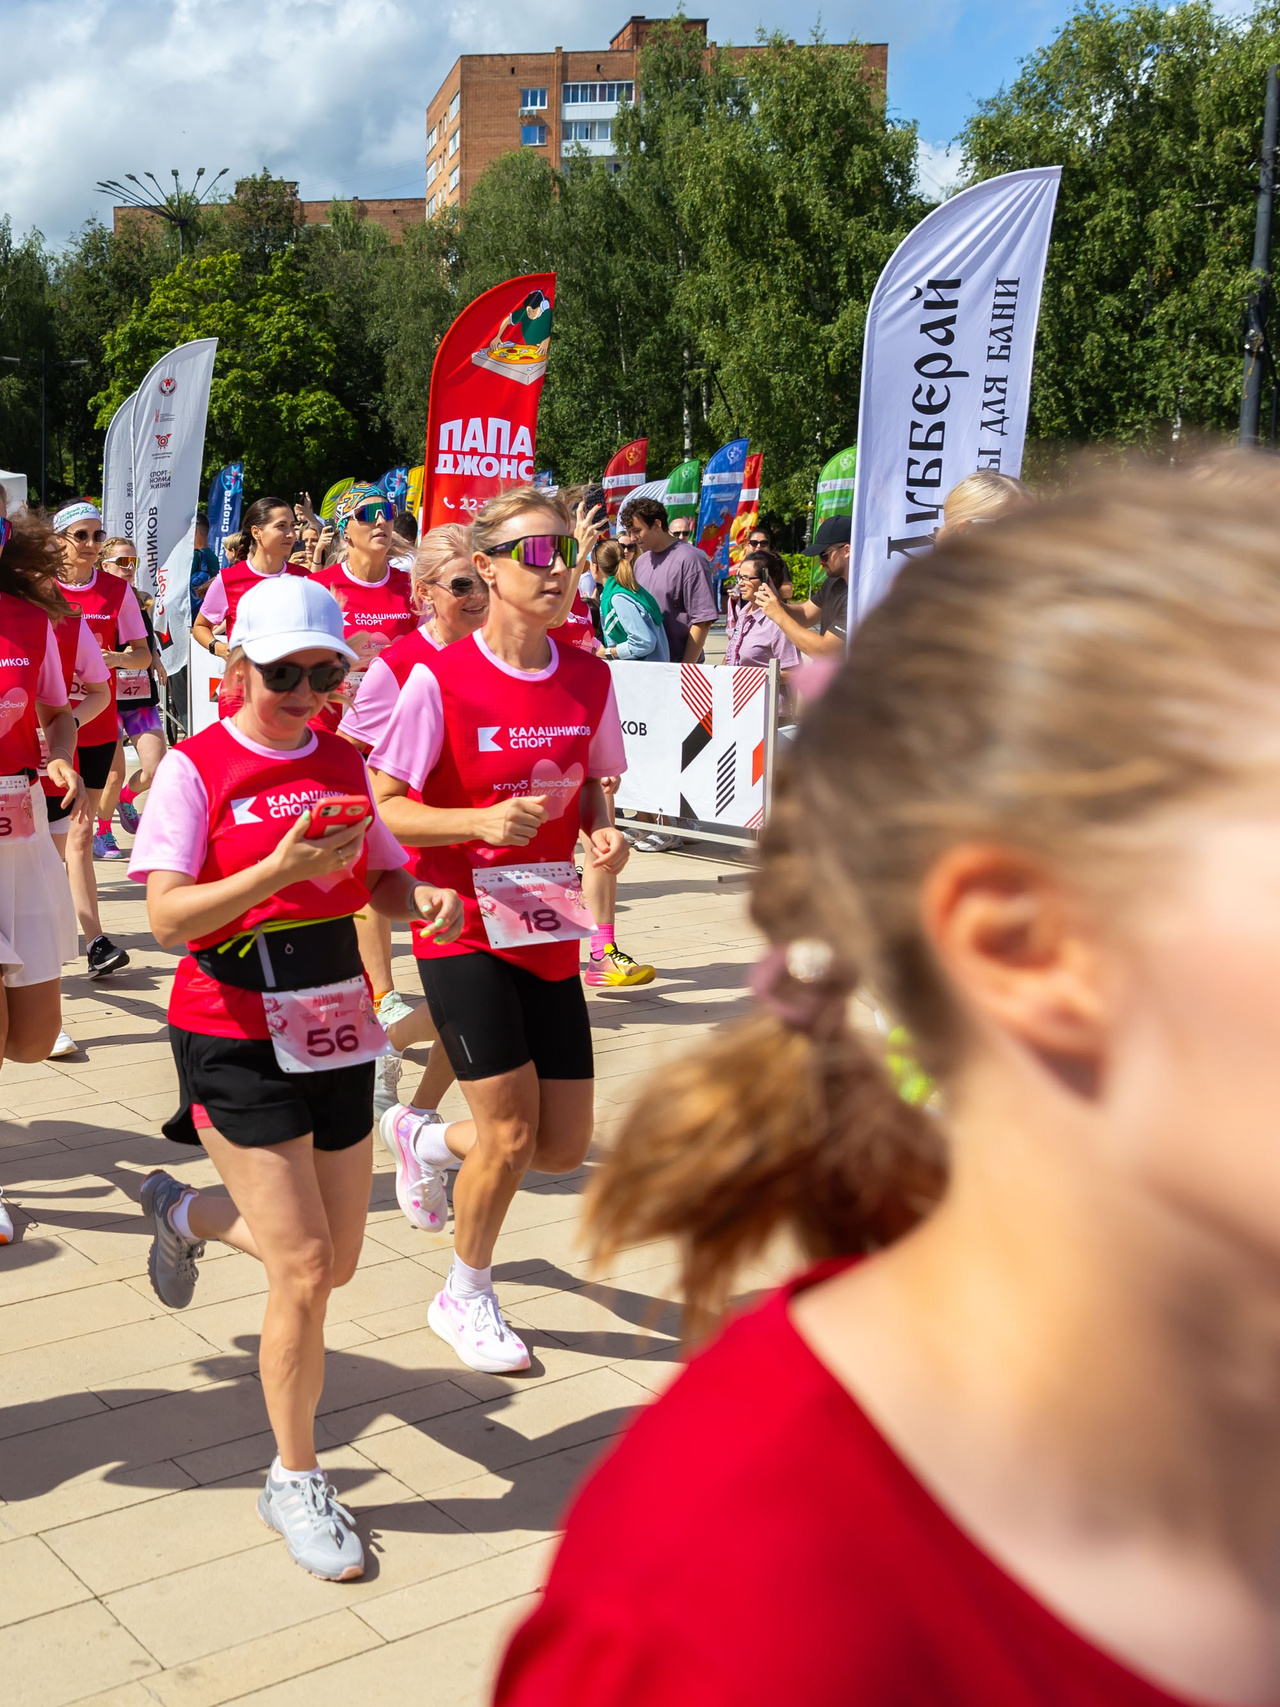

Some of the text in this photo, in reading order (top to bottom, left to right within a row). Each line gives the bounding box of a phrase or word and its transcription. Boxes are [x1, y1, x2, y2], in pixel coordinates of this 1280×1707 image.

[439, 417, 534, 457] ПАПА
[434, 453, 534, 482] ДЖОНС
[221, 490, 232, 532] Спорта
[123, 686, 141, 696] 47
[508, 725, 591, 738] КАЛАШНИКОВ
[509, 737, 553, 749] СПОРТ
[492, 780, 529, 792] клуб
[519, 909, 562, 934] 18
[306, 1024, 360, 1057] 56
